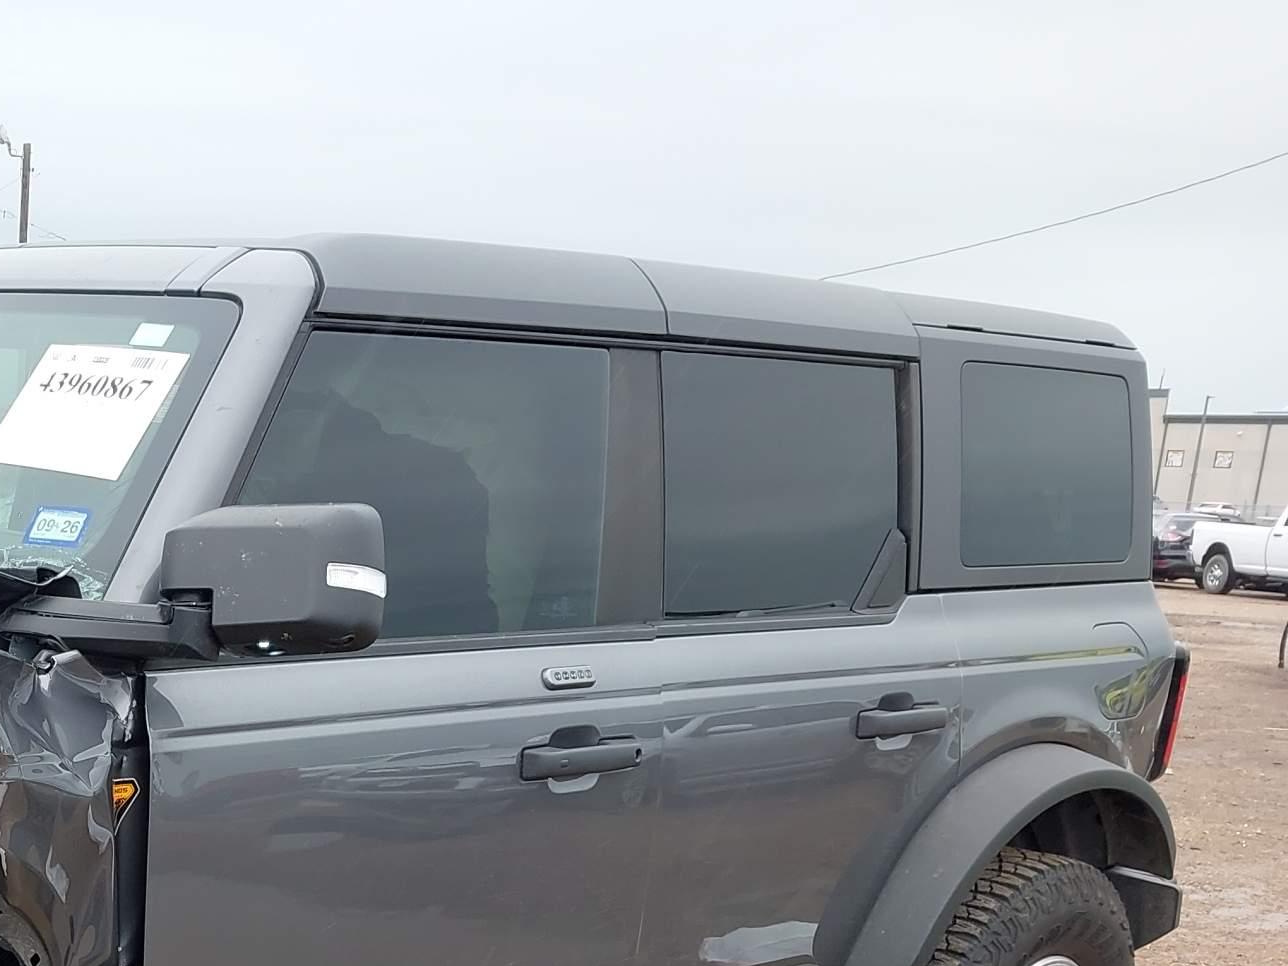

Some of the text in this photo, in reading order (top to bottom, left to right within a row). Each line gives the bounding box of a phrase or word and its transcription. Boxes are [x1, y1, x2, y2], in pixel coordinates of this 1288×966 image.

[40, 371, 154, 401] 43960867
[37, 518, 81, 534] 09 26
